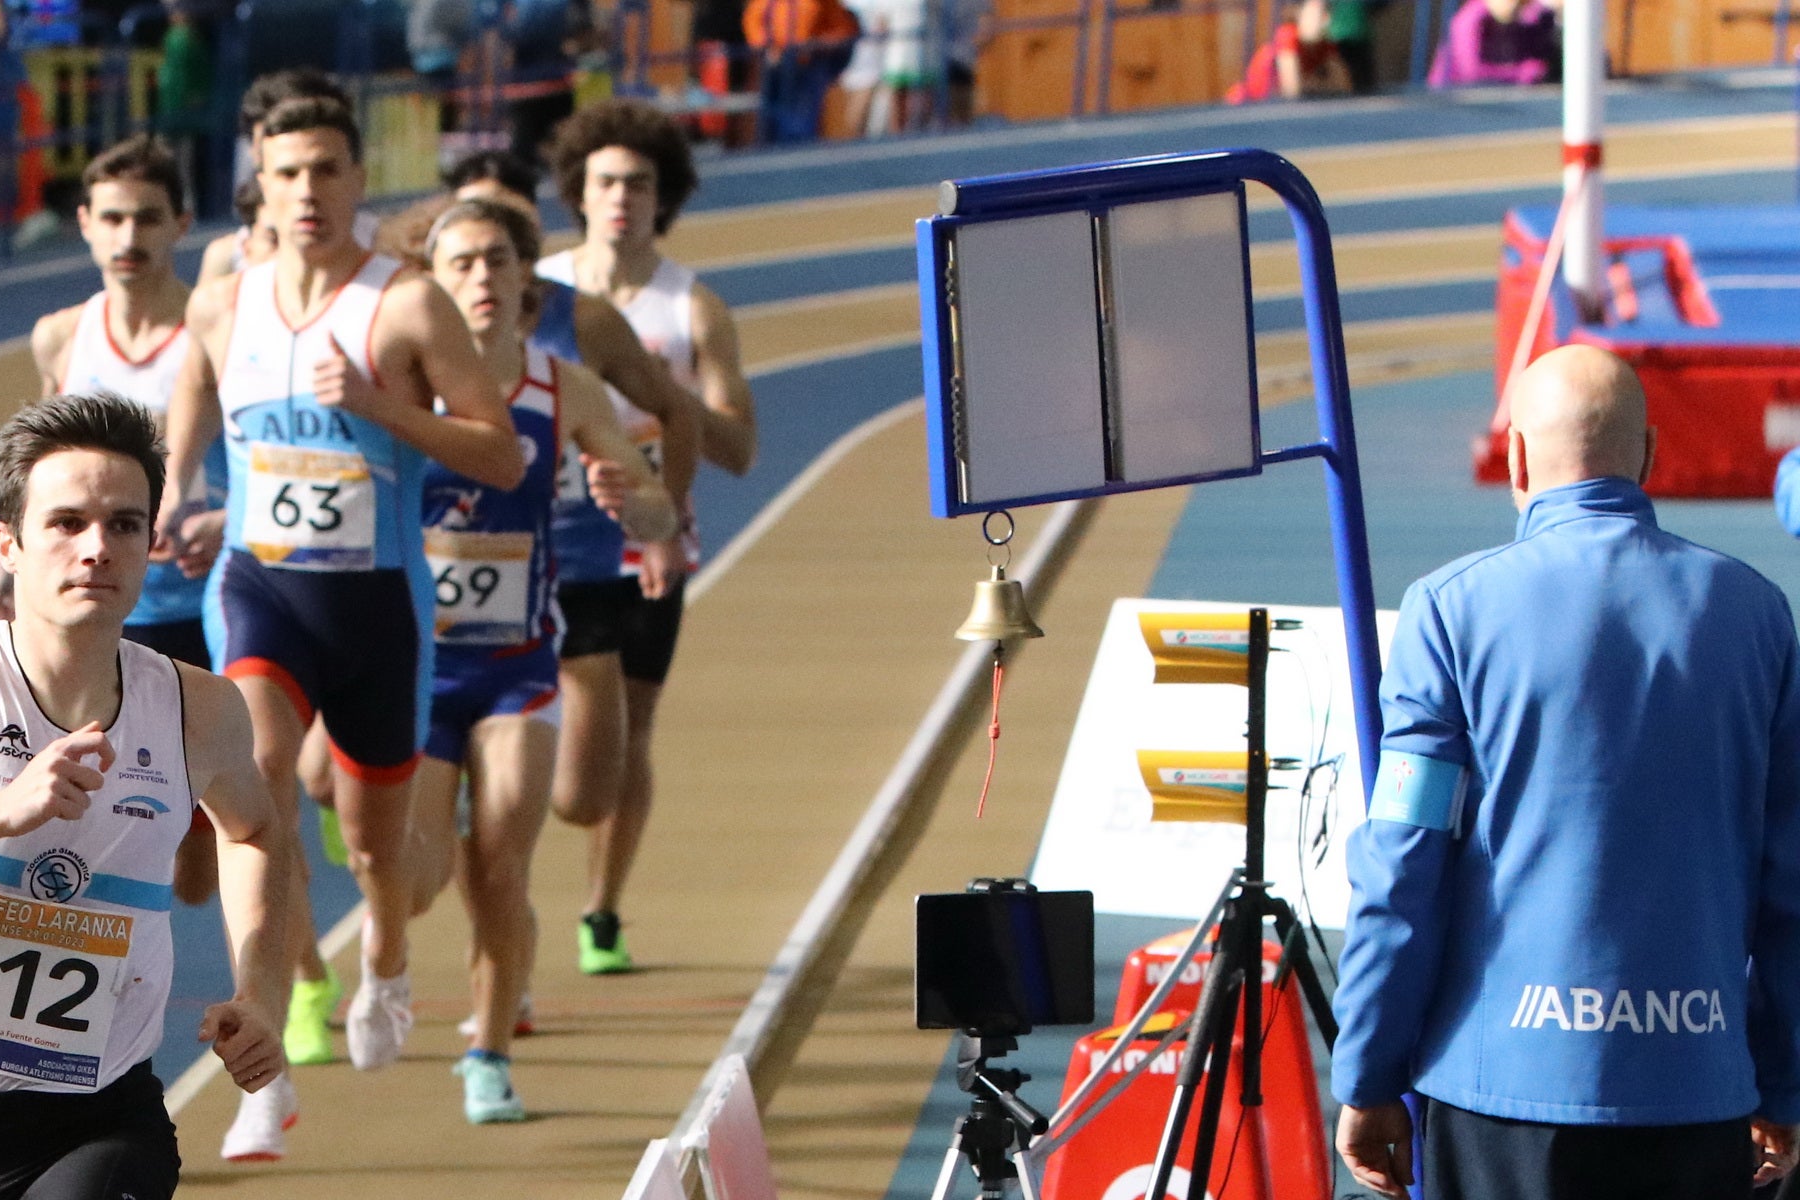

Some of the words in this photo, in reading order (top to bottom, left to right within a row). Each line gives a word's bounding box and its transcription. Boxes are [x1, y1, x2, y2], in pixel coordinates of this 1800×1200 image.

[272, 482, 343, 532] 63
[437, 565, 500, 608] 69
[27, 848, 58, 873] SOCIEDAD
[37, 907, 127, 940] LARANXA
[1531, 985, 1727, 1034] ABANCA
[6, 1030, 33, 1043] Fuente
[34, 1037, 61, 1049] Gomez
[0, 1060, 29, 1075] BURGAS
[29, 1066, 65, 1081] ATLETISMO
[65, 1073, 96, 1086] OURENSE
[76, 1065, 97, 1075] OIKEA
